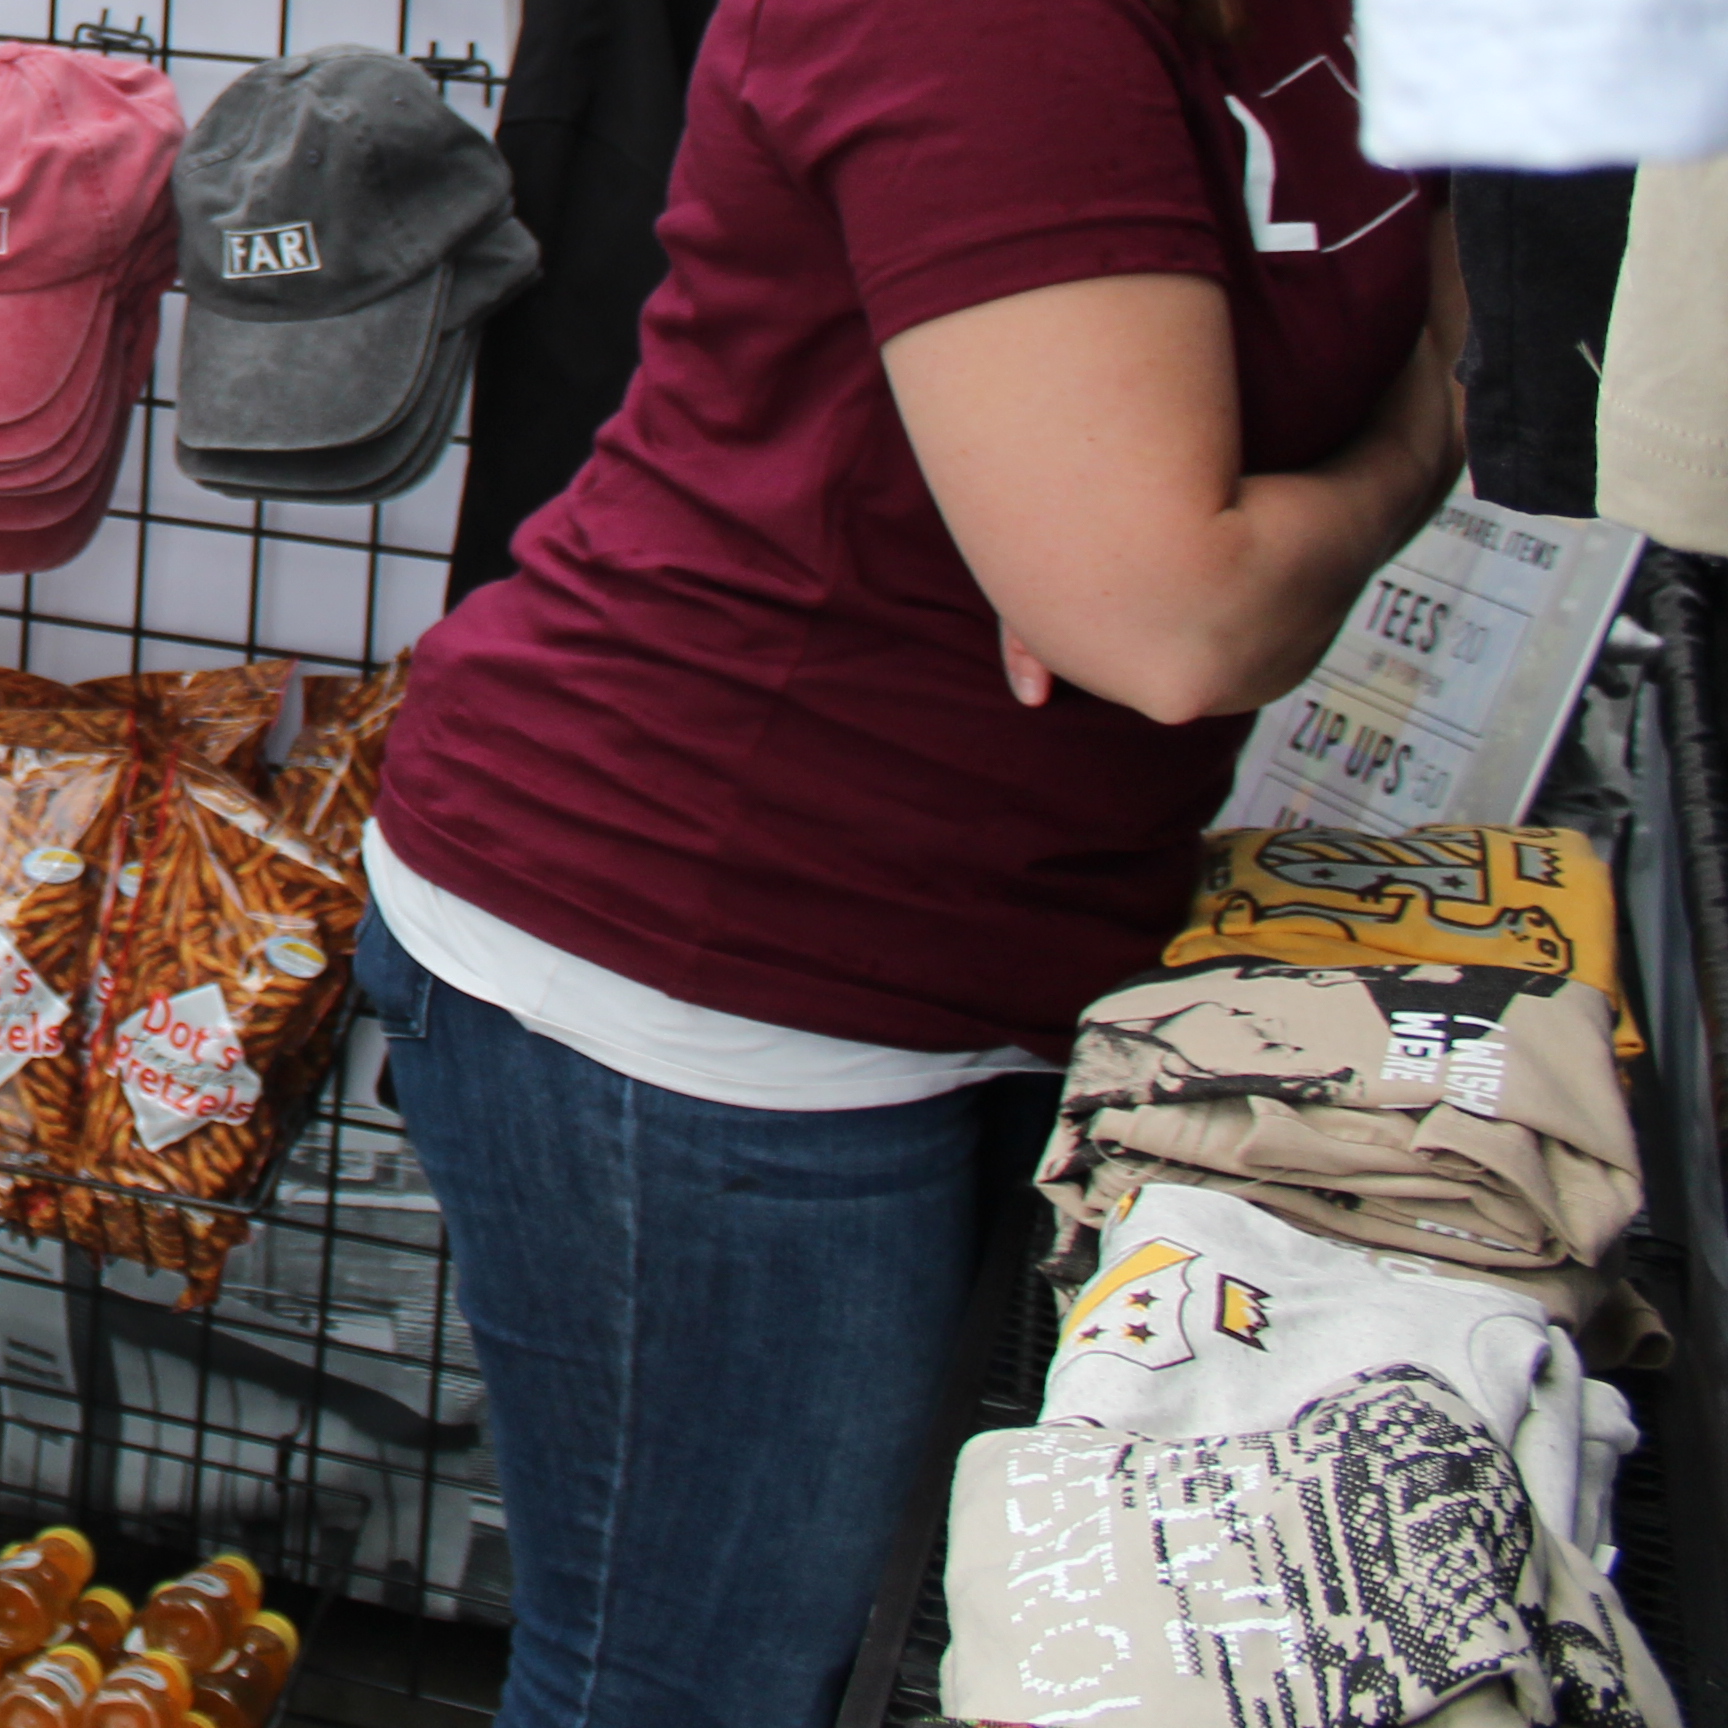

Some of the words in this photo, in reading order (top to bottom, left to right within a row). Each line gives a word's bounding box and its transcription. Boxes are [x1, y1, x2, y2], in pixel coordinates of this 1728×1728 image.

[228, 229, 308, 270] FAR
[1504, 531, 1560, 569] ITEMS
[1365, 580, 1448, 653] TEES
[1289, 700, 1346, 760] ZIP
[1344, 726, 1413, 794] UPS
[143, 992, 244, 1072] Dot's
[1381, 1010, 1446, 1084] WERE
[107, 1034, 255, 1119] Pretzels
[1441, 1037, 1505, 1118] WISH
